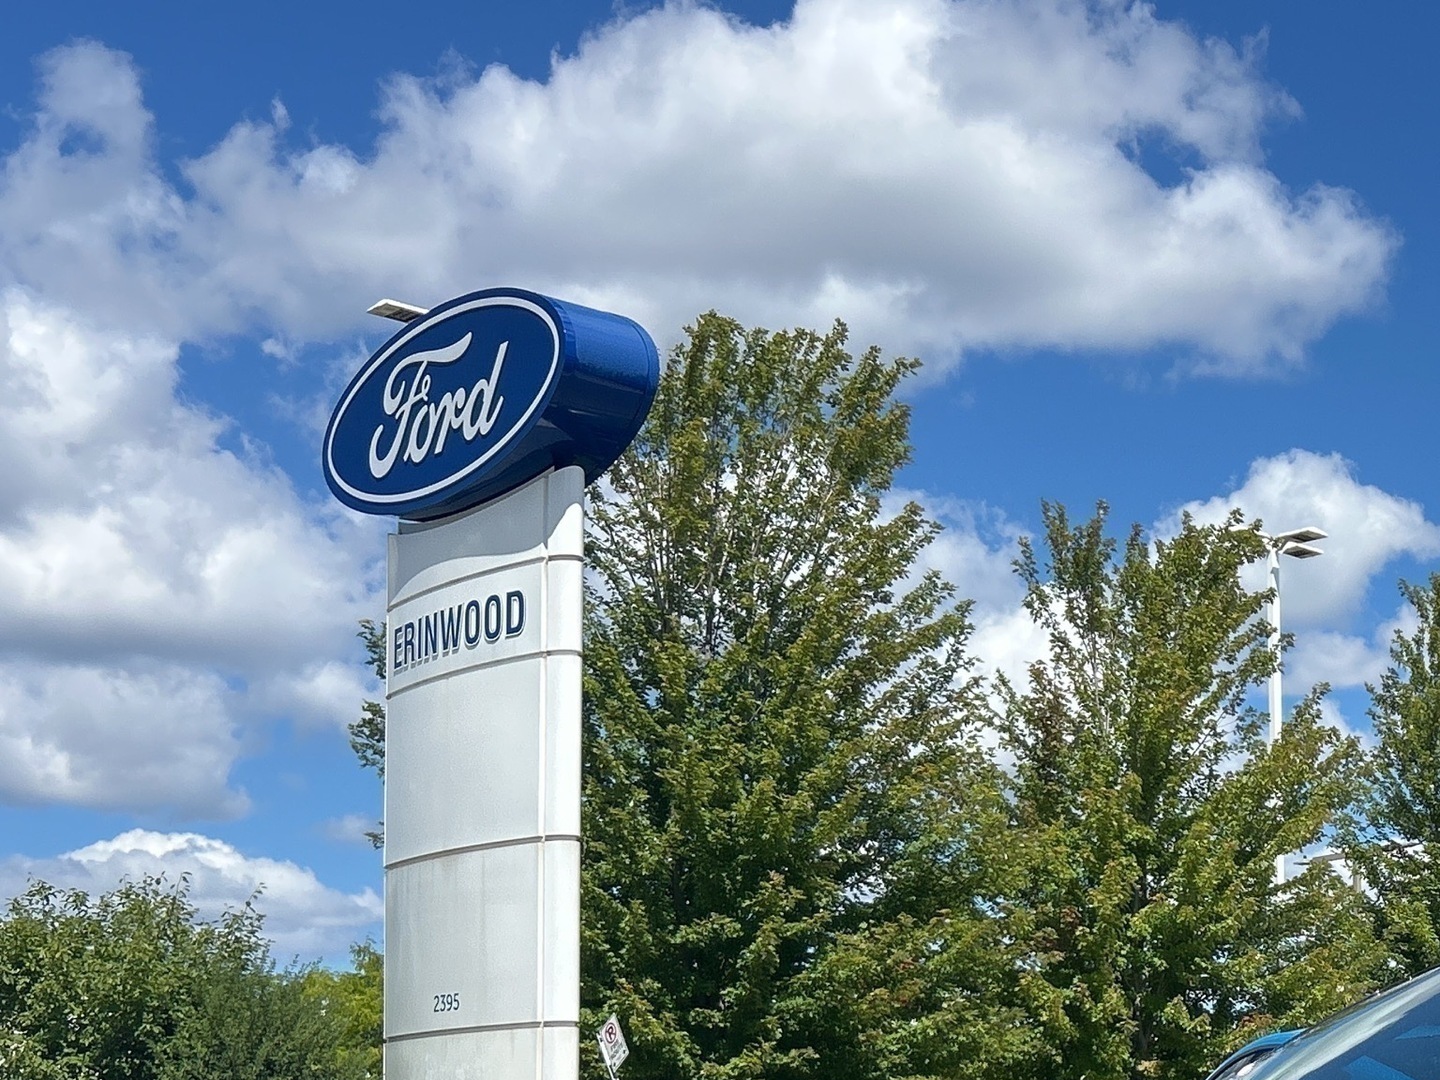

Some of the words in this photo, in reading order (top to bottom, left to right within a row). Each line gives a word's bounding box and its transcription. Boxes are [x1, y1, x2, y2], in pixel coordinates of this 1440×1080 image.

[368, 331, 509, 479] Ford
[393, 589, 527, 672] ERINWOOD
[433, 992, 460, 1013] 2395
